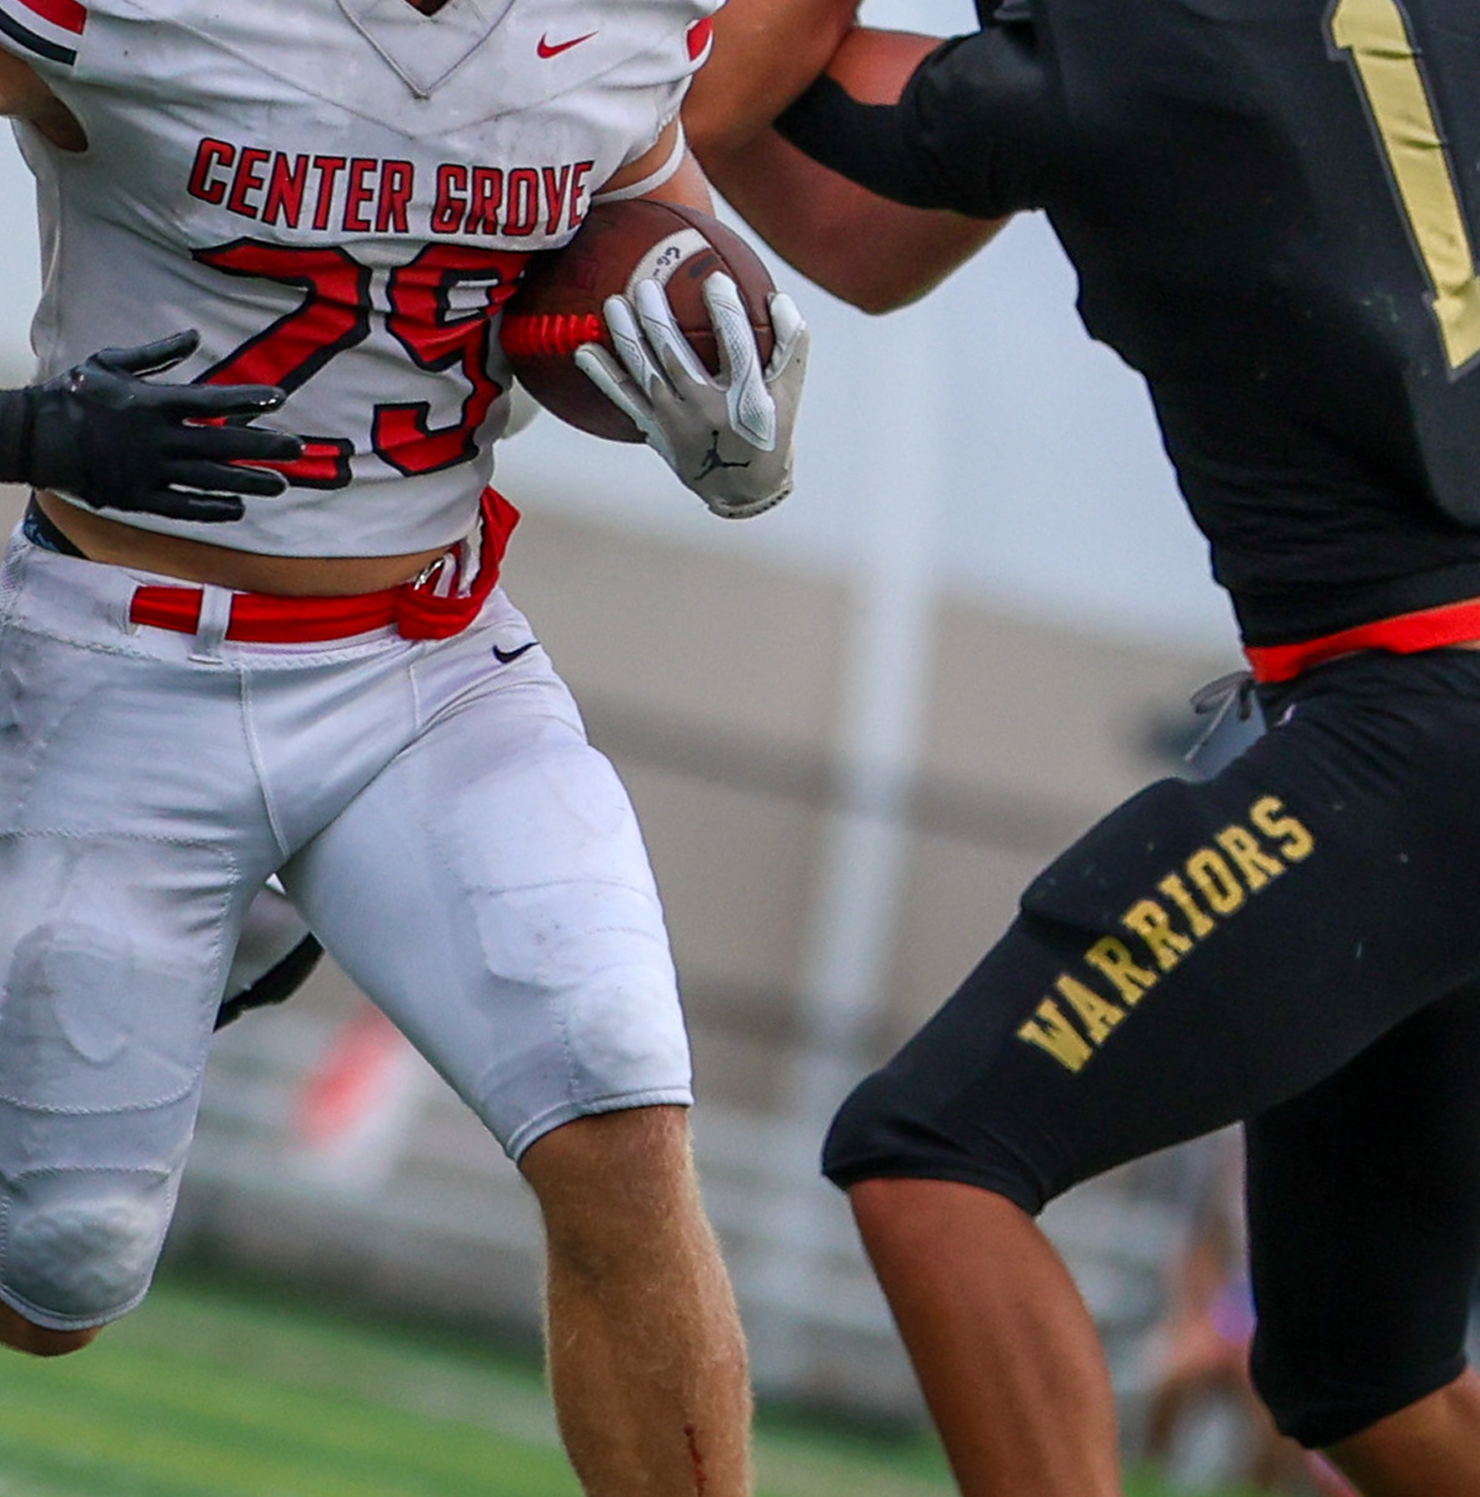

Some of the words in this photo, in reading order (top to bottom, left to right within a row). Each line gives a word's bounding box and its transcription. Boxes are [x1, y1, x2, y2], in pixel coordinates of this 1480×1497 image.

[187, 137, 414, 233] CENTER
[430, 160, 595, 236] GROVE
[189, 236, 532, 490] 29
[1016, 795, 1316, 1074] WARRIORS
